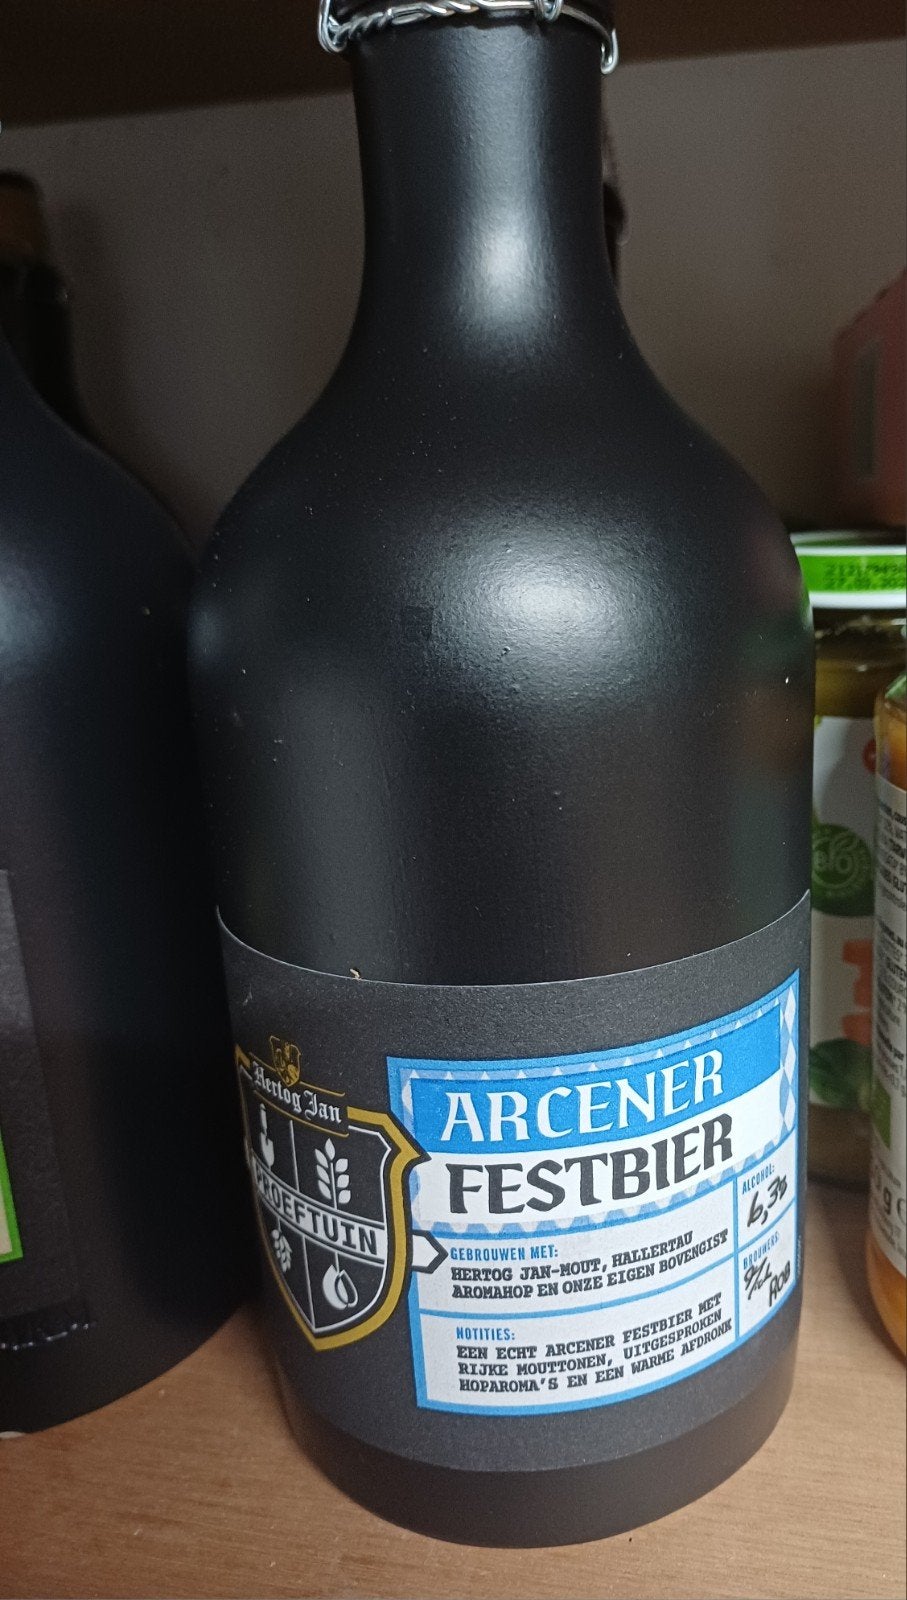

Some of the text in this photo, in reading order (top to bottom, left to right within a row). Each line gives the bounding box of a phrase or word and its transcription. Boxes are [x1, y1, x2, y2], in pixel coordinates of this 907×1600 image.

[253, 1060, 342, 1123] Hertog Jan
[441, 1049, 723, 1142] ARCENER
[446, 1113, 733, 1214] FESTBIER
[742, 1165, 775, 1195] ALCOHOL:
[450, 1244, 559, 1262] GEBROUWEN MET:
[451, 1230, 694, 1282] HERTOG JAN-MOUT, HALLERTAU
[451, 1228, 729, 1299] AROMAHOP EN ONZE EIGEN BOVENGIST
[743, 1230, 780, 1270] BROUWERS:
[456, 1327, 515, 1341] NOTITIES:
[457, 1292, 722, 1359] EEN ECHT ARCENER FESTBIER MET
[458, 1308, 723, 1376] RIJKE MOUTTONEN, UITGESPROKEN
[459, 1318, 733, 1392] HOPAROMA'S EN EEN WARME AFDRONK
